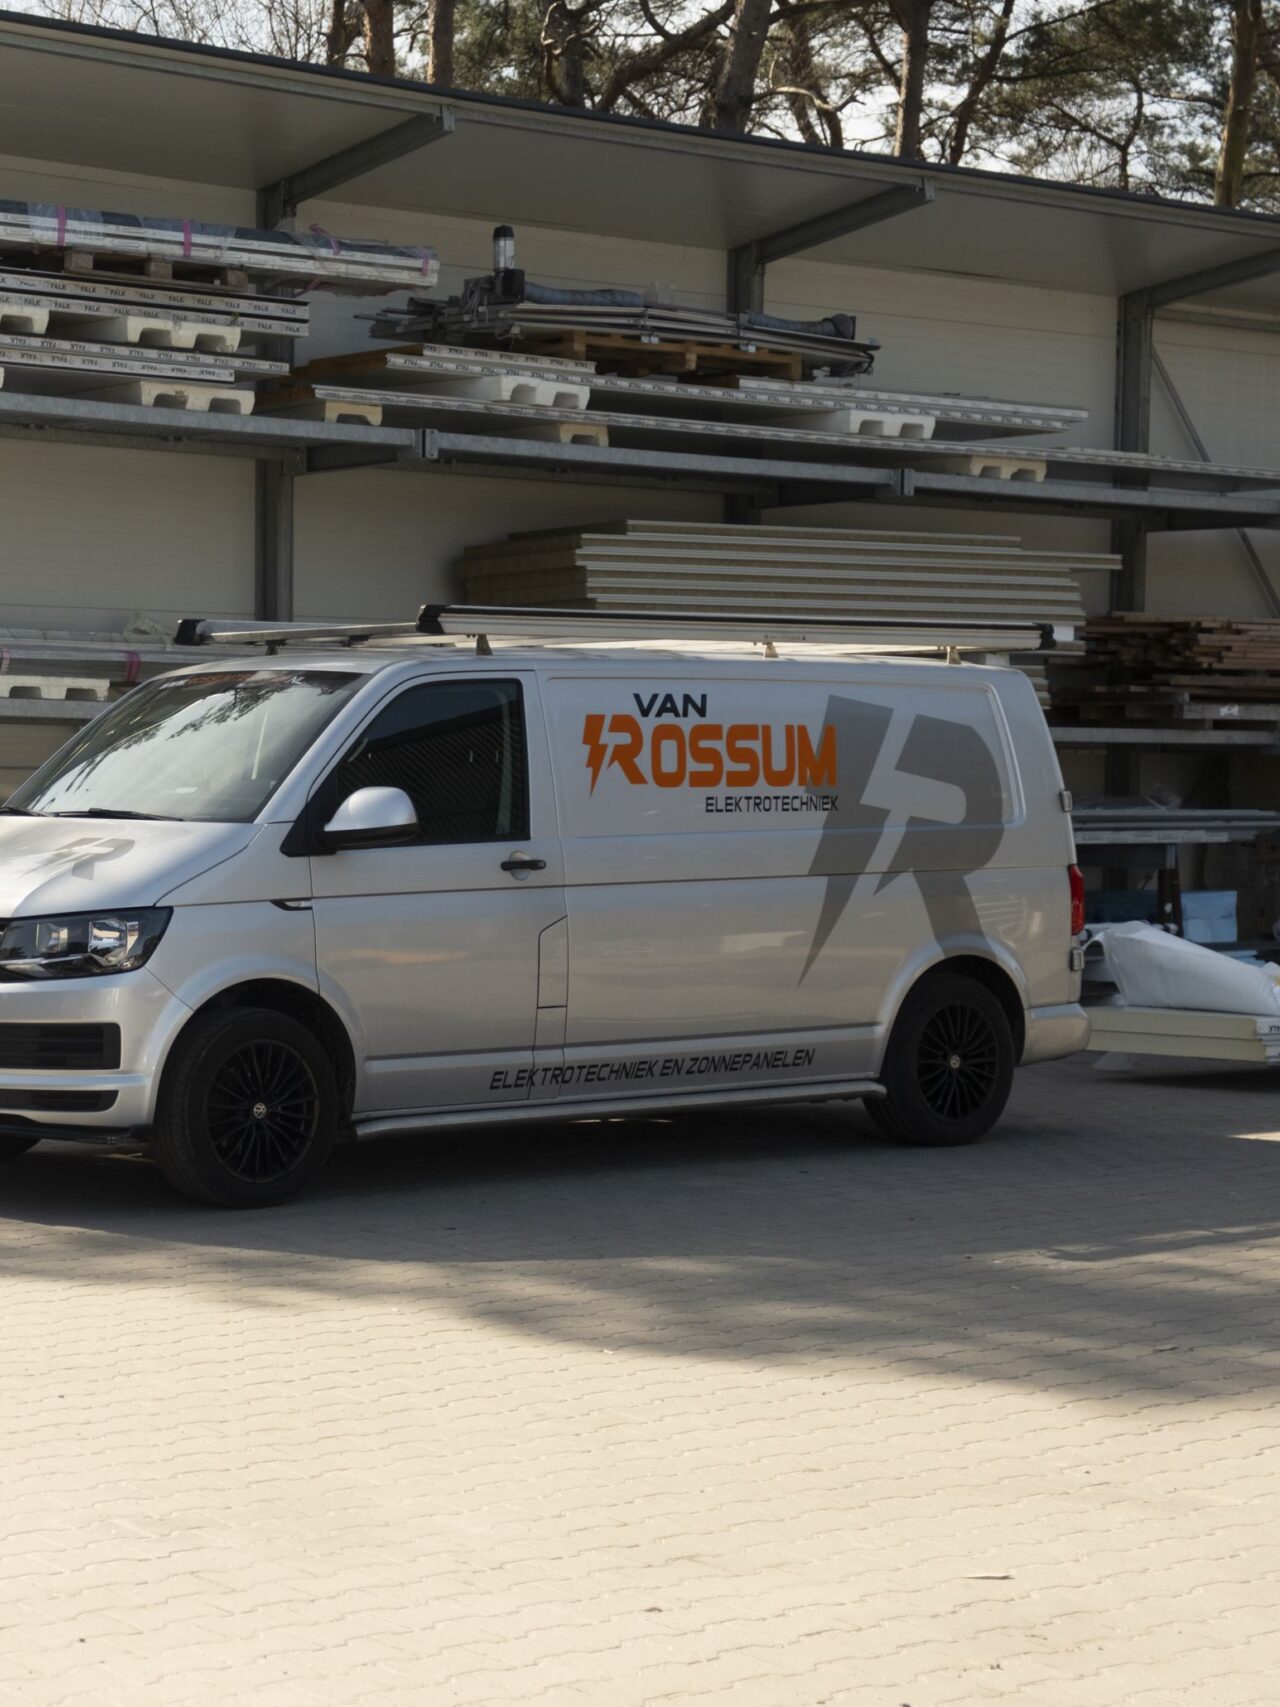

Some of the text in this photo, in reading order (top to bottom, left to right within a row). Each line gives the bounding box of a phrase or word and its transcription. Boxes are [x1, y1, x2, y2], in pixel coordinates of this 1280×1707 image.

[50, 282, 66, 290] FALK
[80, 286, 96, 294] FALK
[110, 289, 125, 297] FALK
[139, 292, 155, 300] FALK
[169, 295, 184, 303] FALK
[197, 297, 213, 305] FALK
[226, 301, 240, 309] FALK
[254, 304, 268, 312] FALK
[24, 297, 40, 305] FALK
[54, 301, 70, 309] FALK
[84, 304, 100, 312] FALK
[144, 310, 159, 318] FALK
[172, 313, 187, 321] FALK
[285, 325, 300, 333] FALK
[10, 337, 26, 345] FALK
[40, 341, 56, 349] FALK
[70, 343, 86, 351] FALK
[99, 346, 115, 354] FALK
[185, 355, 201, 363] FALK
[212, 358, 228, 366] FALK
[240, 360, 256, 368] FALK
[20, 352, 37, 360] FALK
[51, 355, 68, 363] FALK
[81, 358, 98, 366] FALK
[170, 367, 187, 375] FALK
[633, 693, 707, 718] VAN
[582, 714, 837, 799] ROSSUM
[705, 796, 839, 813] ELEKTROTECHNIEK
[489, 1049, 816, 1090] ELEKTROTECHNIEK EN ZONNEPANELEN
